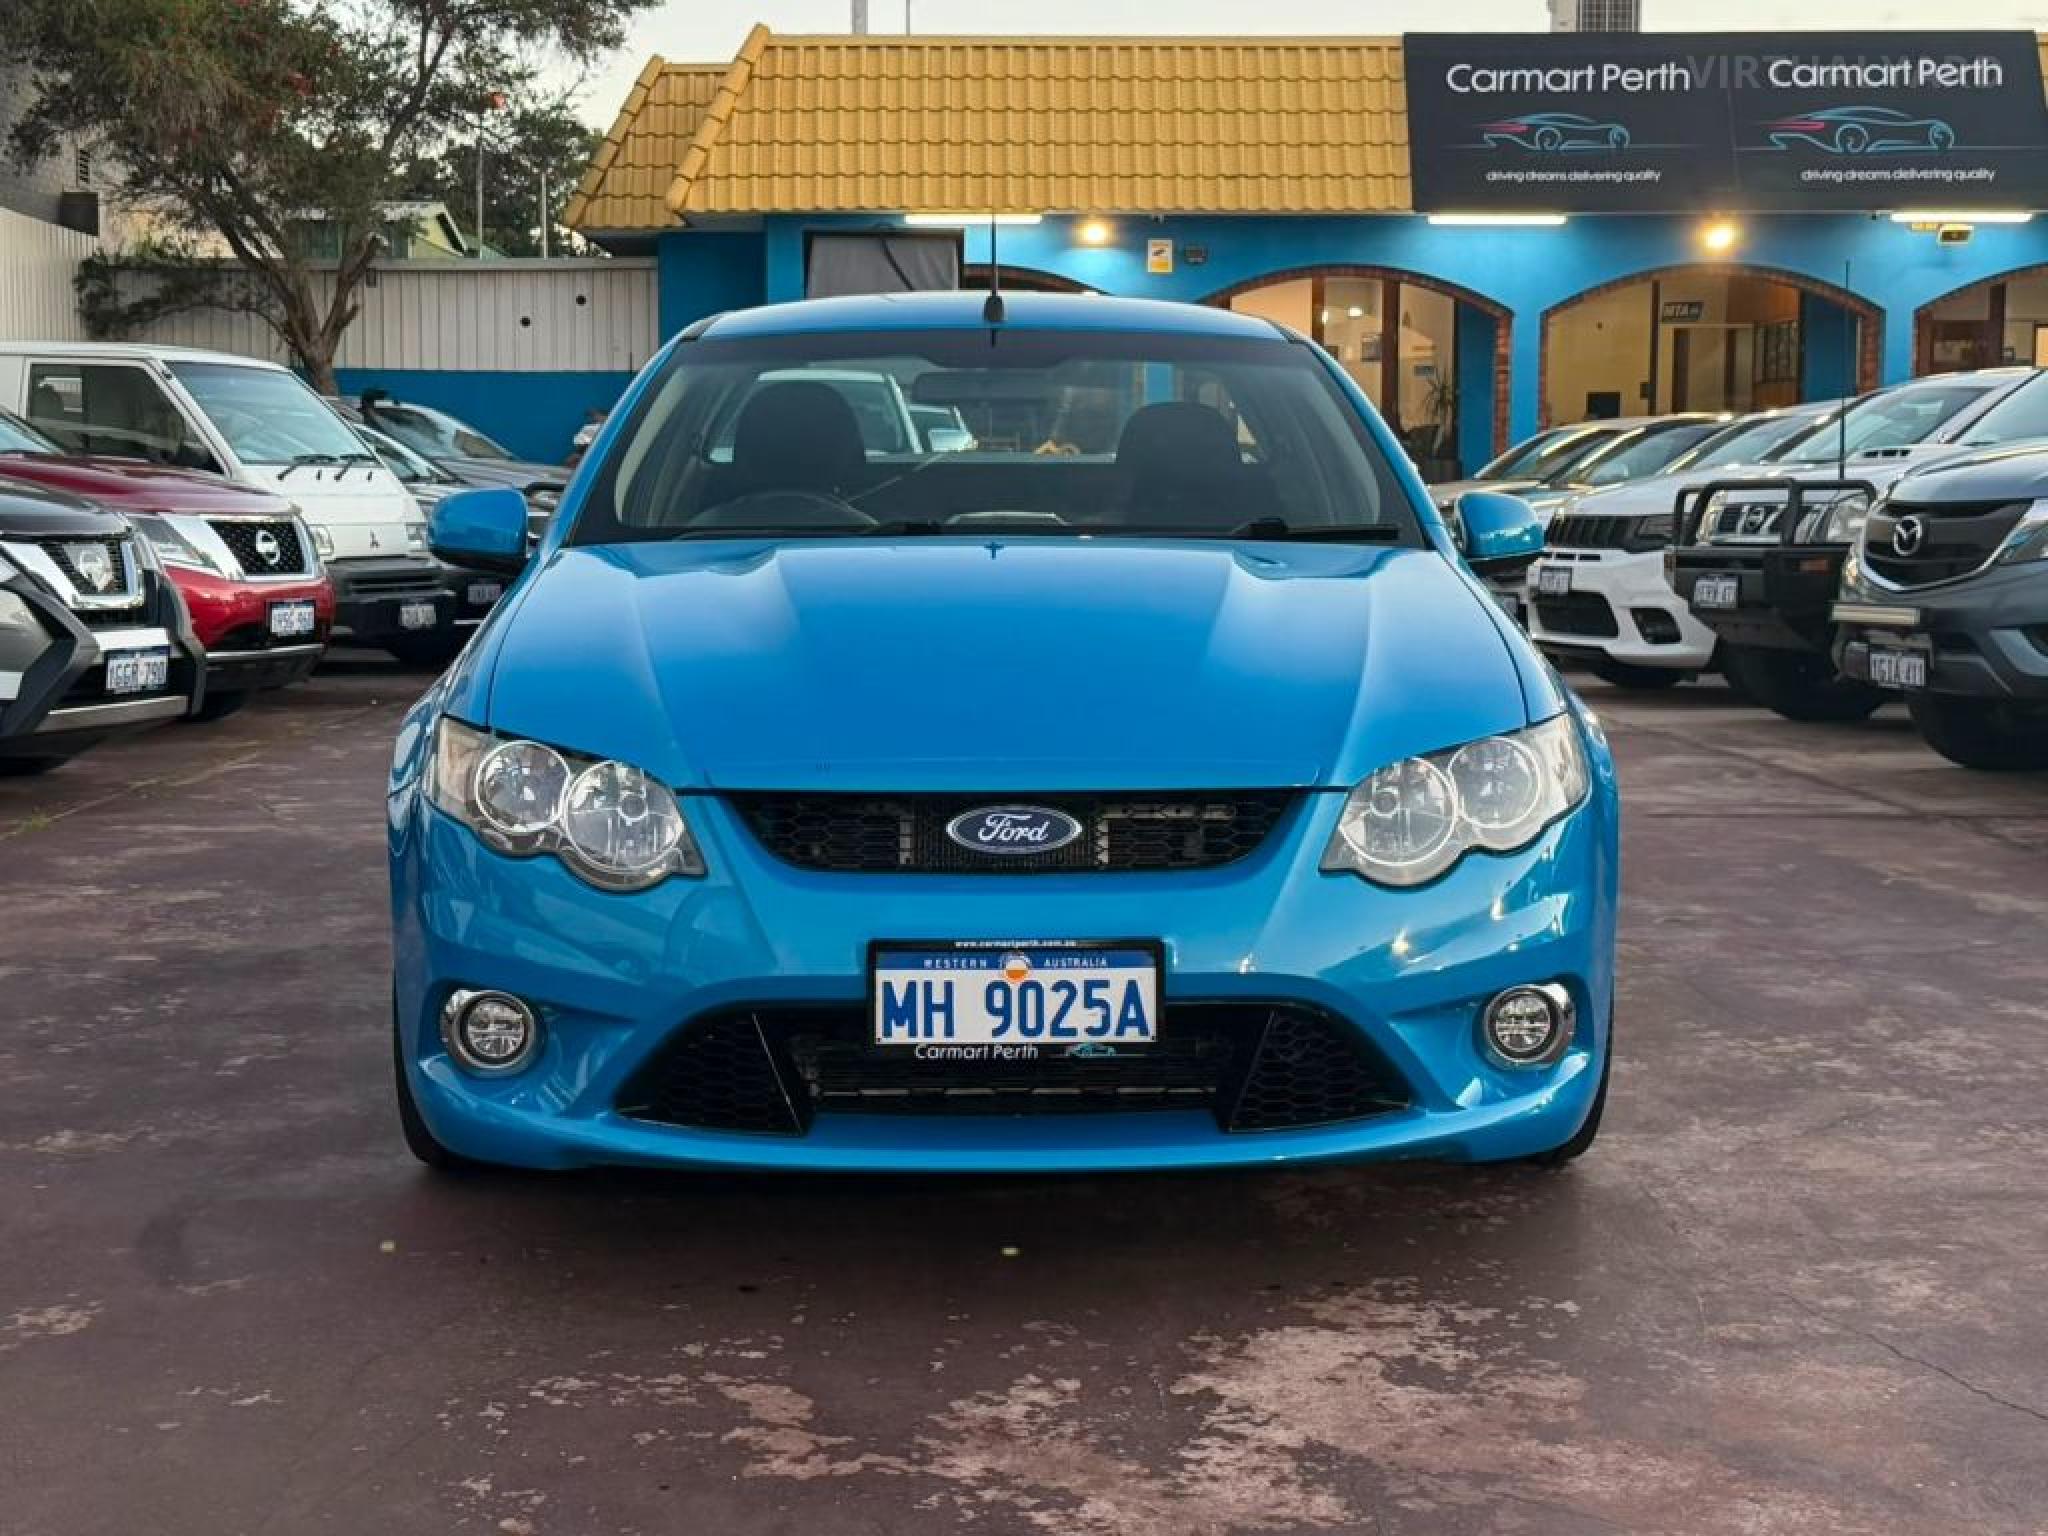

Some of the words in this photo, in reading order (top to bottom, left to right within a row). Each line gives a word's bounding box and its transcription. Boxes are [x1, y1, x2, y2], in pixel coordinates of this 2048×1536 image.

[1447, 64, 1596, 92] Carmart
[1603, 62, 1690, 92] Perth
[1768, 59, 1912, 87] Carmart
[1919, 58, 2003, 87] Perth
[1487, 169, 1524, 183] driving
[1526, 169, 1567, 181] dreams
[1568, 169, 1622, 183] delivering
[1624, 168, 1661, 183] quality
[1802, 169, 1842, 183] driving
[1845, 168, 1890, 181] dreams
[1893, 168, 1952, 183] delivering
[1954, 168, 1994, 183] quality
[977, 813, 1050, 842] Ford
[923, 958, 988, 969] WESTERN
[1043, 957, 1108, 968] AUSTRALIA
[881, 979, 956, 1039] MH
[984, 978, 1150, 1039] 9025A
[914, 1043, 988, 1060] Carmart
[994, 1043, 1039, 1060] Perth
